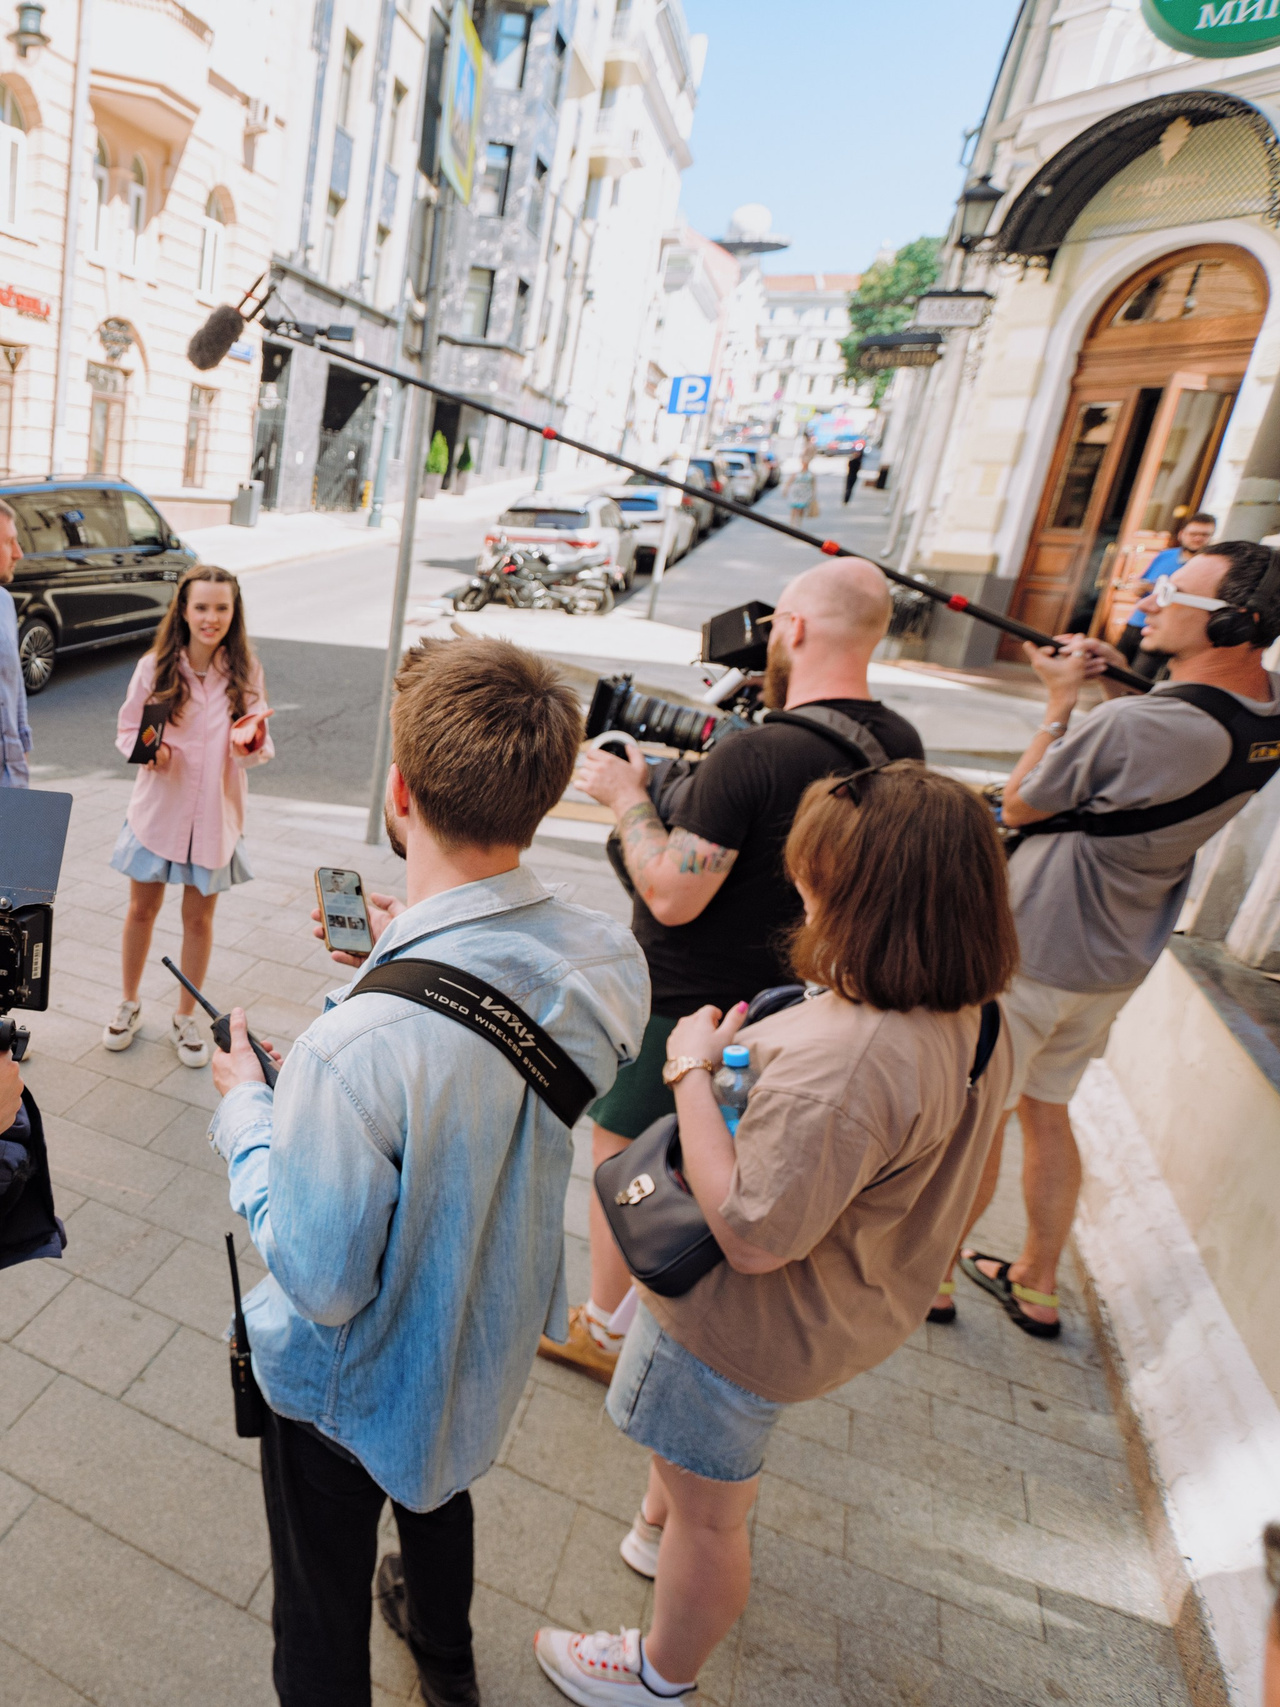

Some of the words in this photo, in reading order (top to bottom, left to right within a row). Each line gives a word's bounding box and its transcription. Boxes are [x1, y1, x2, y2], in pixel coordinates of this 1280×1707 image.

[424, 989, 470, 1016] VIDEO
[475, 1014, 523, 1057] WIRELESS
[522, 1057, 550, 1088] SYSTEM
[480, 996, 536, 1047] VAXIS
